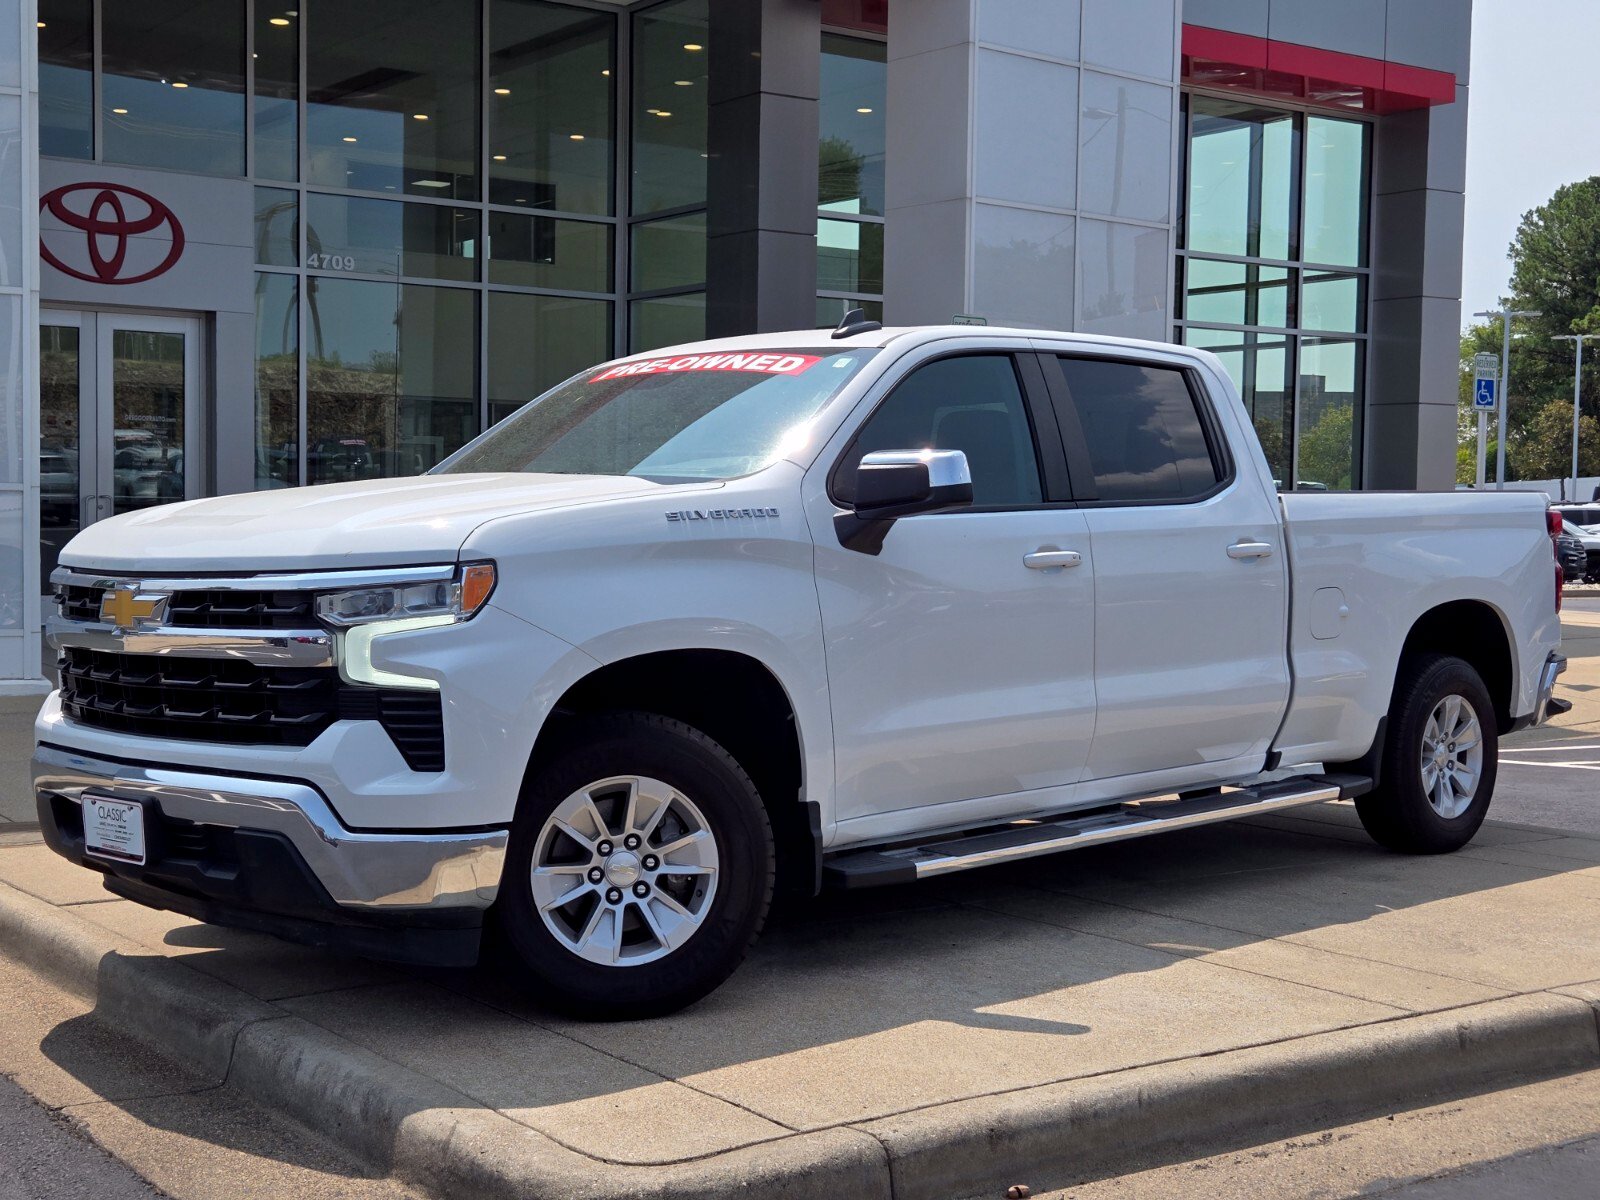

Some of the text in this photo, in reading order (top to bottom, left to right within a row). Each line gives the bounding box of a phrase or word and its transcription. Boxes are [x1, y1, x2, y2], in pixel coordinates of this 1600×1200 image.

[307, 253, 355, 271] 4709
[598, 354, 805, 381] PRE-OWNED
[665, 507, 780, 521] SILVERADO
[97, 806, 127, 823] CLASSIC
